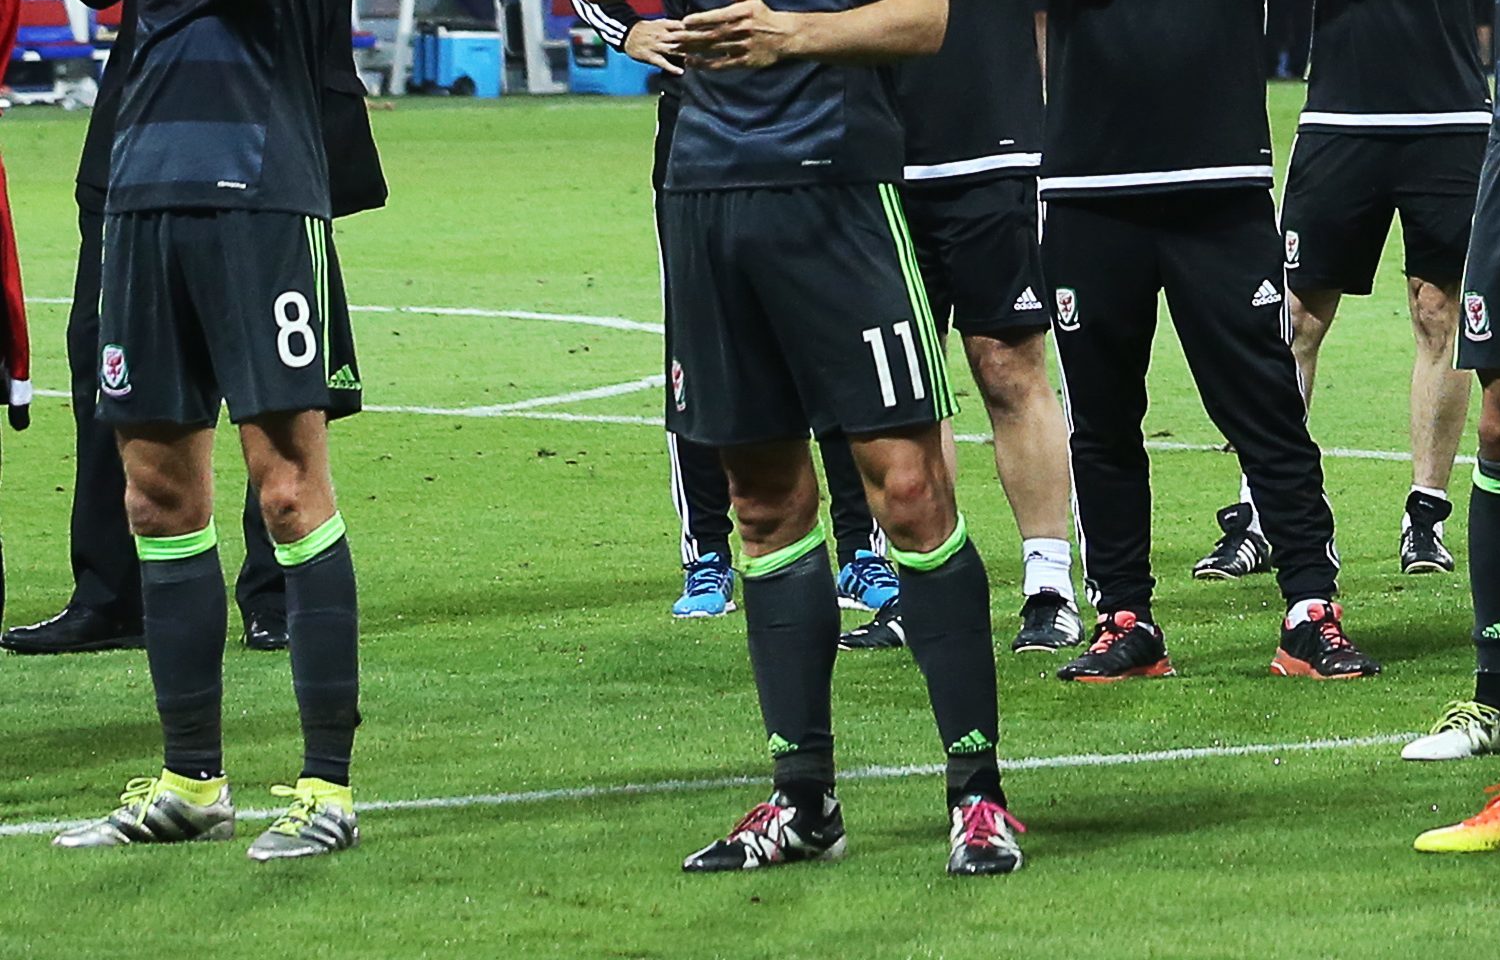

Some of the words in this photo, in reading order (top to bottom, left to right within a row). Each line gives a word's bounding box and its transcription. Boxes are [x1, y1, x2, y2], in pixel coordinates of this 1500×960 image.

[273, 290, 317, 369] 8
[1251, 293, 1283, 307] adidas
[862, 320, 925, 408] 11
